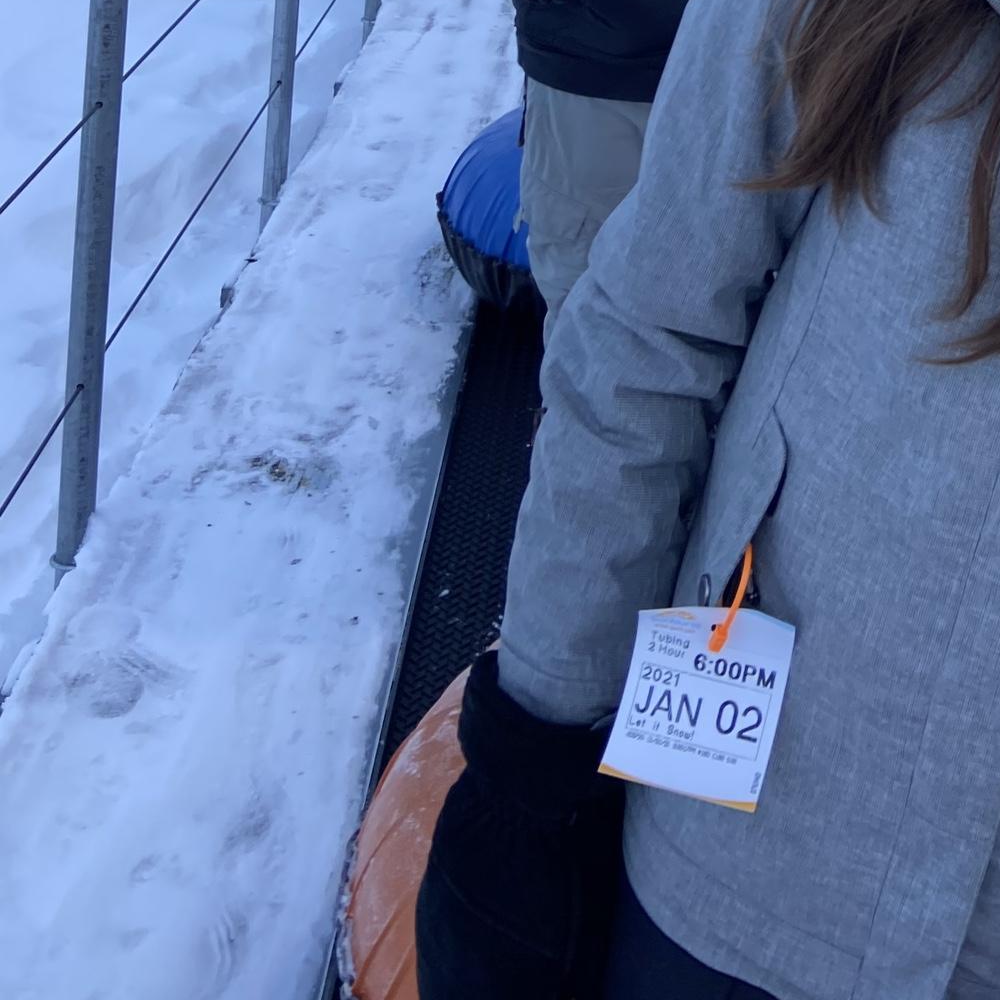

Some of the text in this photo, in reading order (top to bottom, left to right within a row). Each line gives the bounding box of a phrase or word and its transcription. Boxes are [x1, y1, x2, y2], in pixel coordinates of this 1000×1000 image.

[648, 641, 686, 658] 2 Hour
[651, 630, 690, 649] Tubing
[641, 665, 680, 687] 2021
[694, 653, 777, 689] 6:00PM
[634, 685, 763, 743] JAN 02
